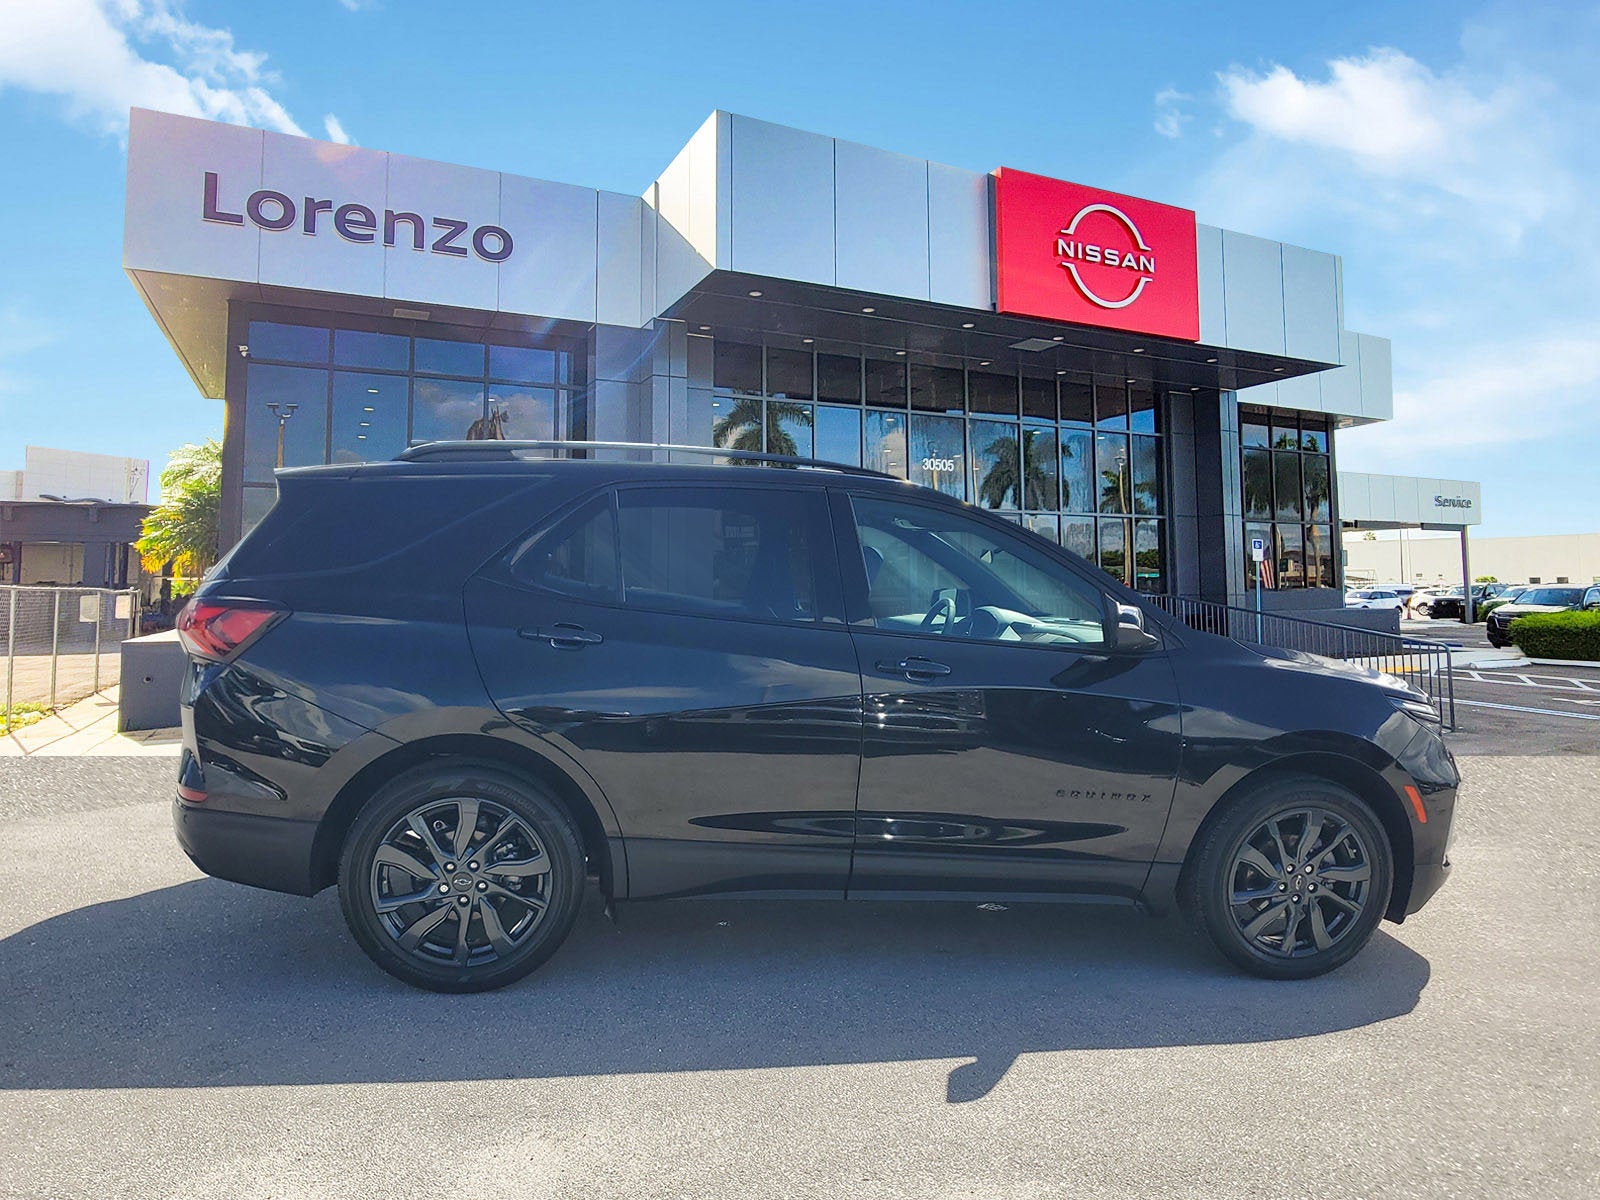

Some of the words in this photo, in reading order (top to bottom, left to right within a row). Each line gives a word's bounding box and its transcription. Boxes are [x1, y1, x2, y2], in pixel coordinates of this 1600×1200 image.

[202, 171, 514, 262] Lorenzo
[1057, 238, 1155, 273] NISSAN
[922, 457, 955, 472] 30505
[1434, 495, 1472, 509] Service
